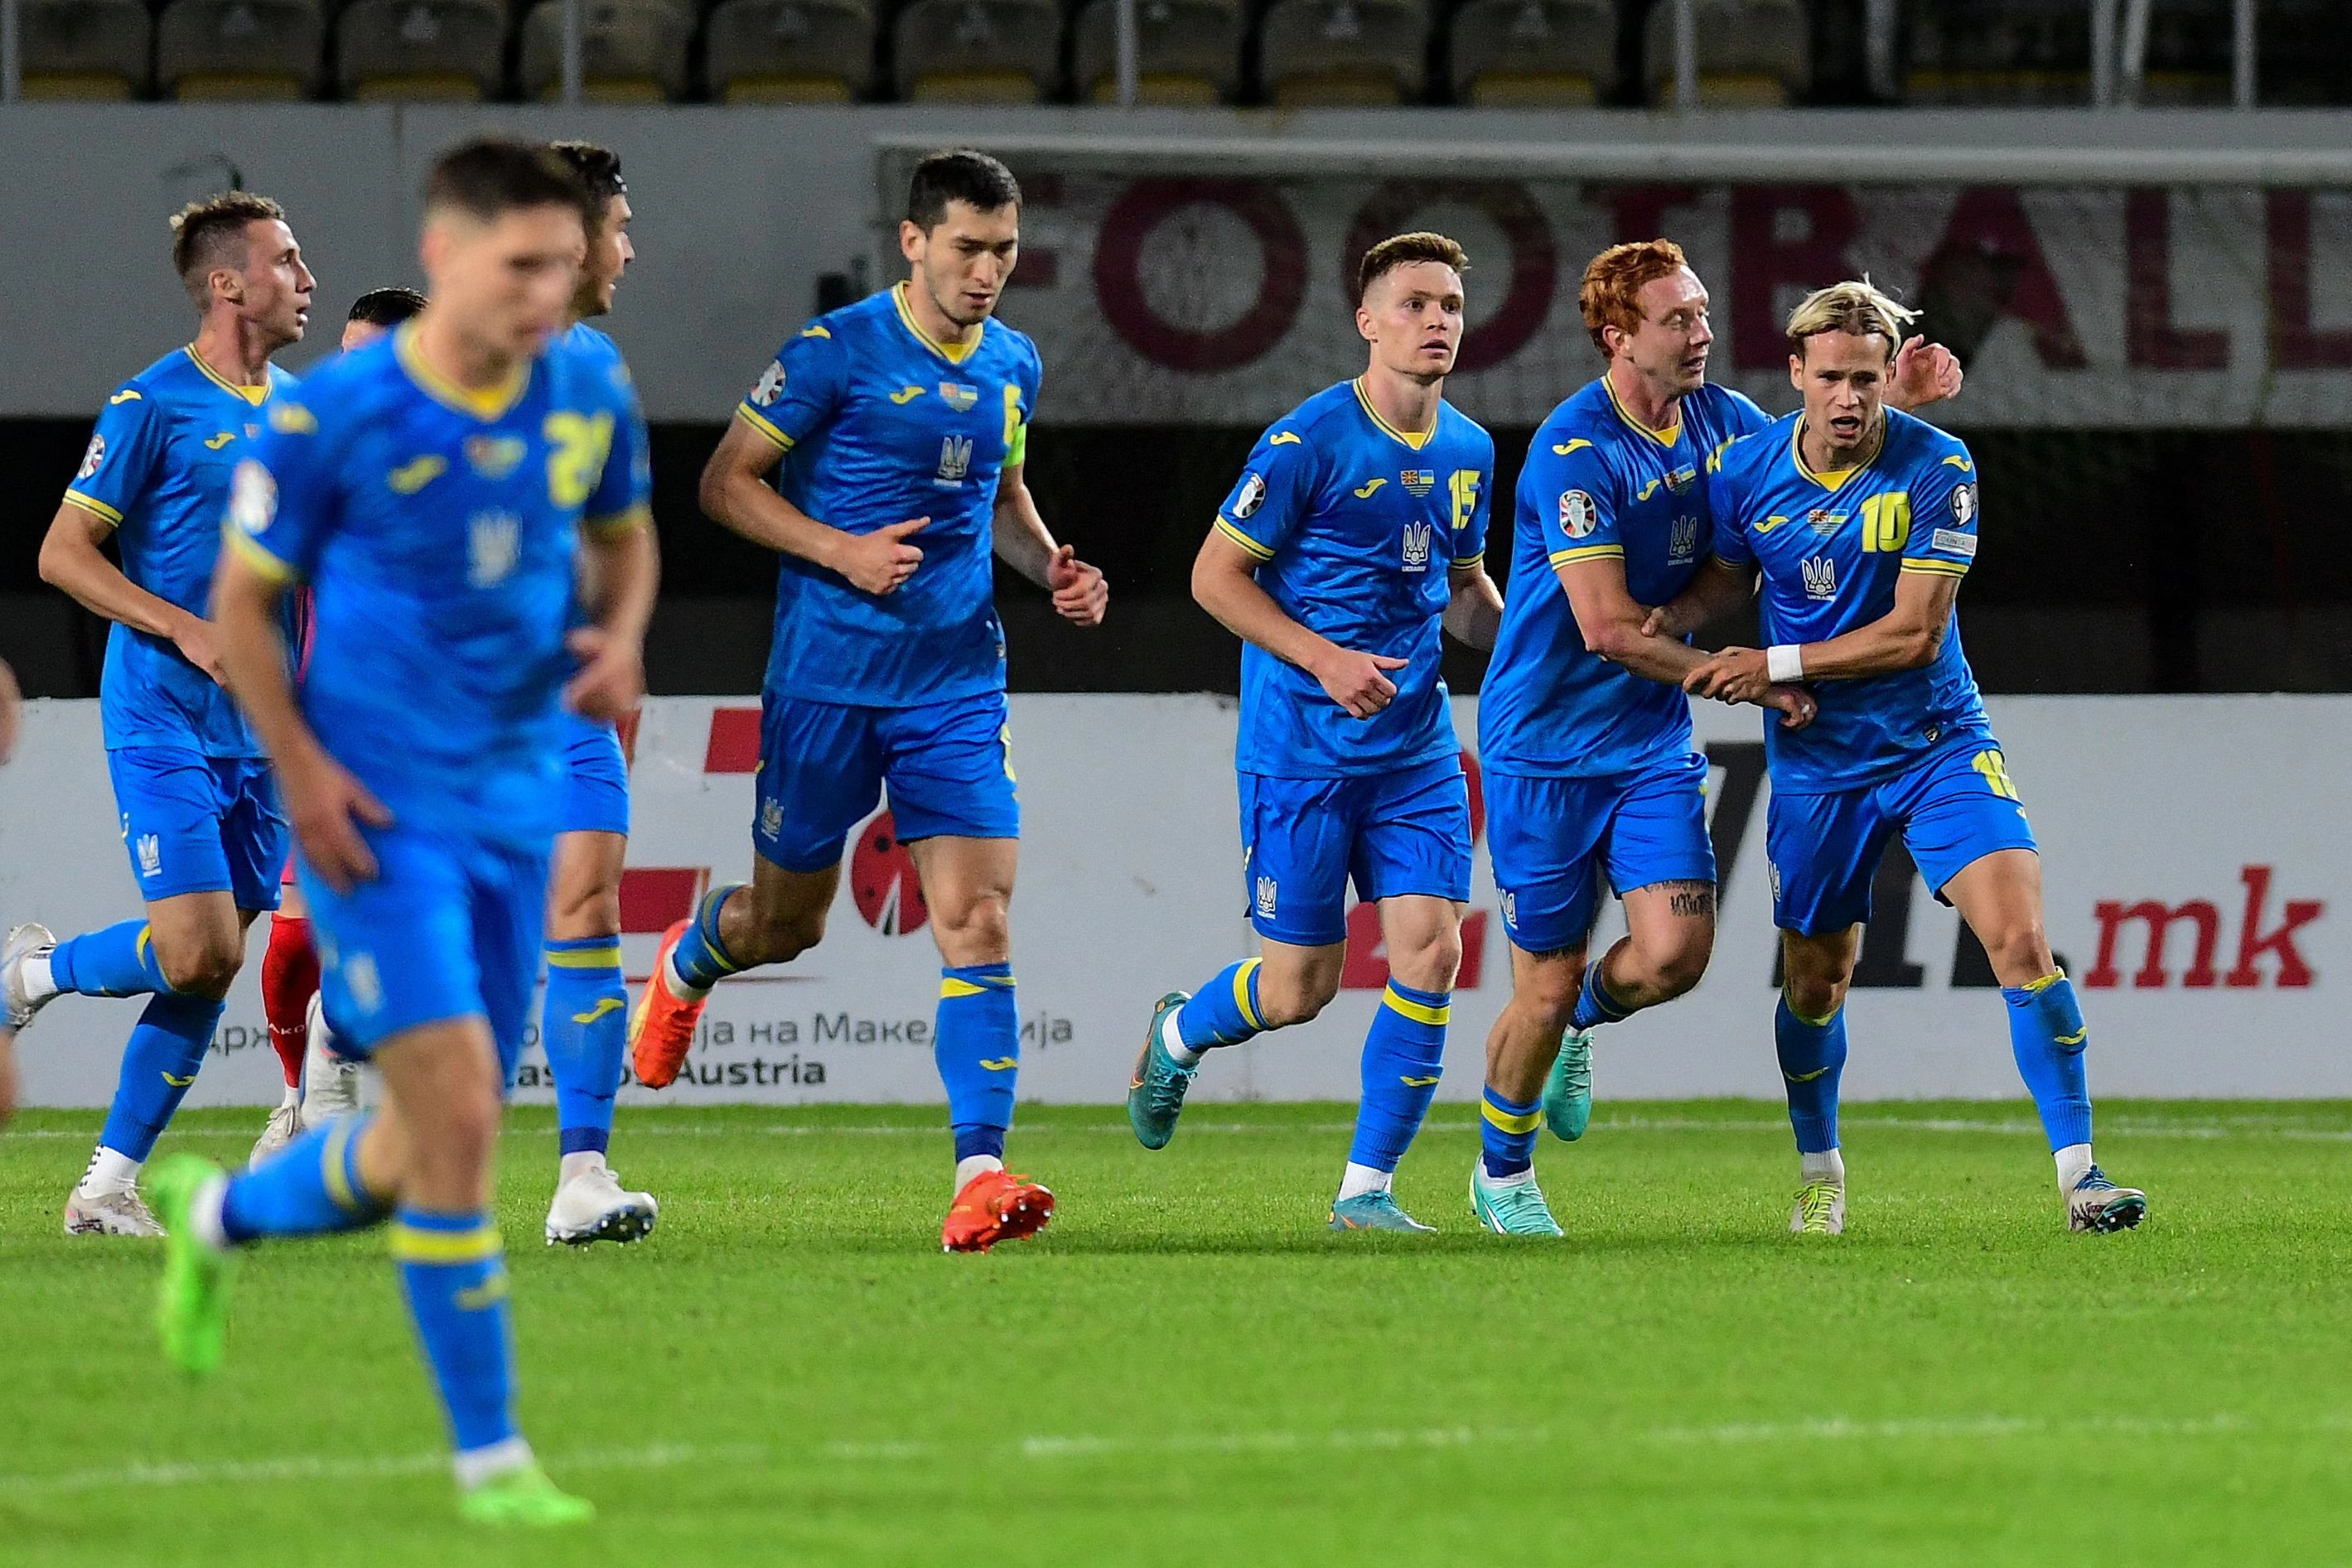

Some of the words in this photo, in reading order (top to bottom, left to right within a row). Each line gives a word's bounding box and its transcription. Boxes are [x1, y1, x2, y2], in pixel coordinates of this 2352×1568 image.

[1448, 469, 1481, 530] 15
[1861, 491, 1910, 552] 10
[750, 1020, 799, 1046] на
[814, 1011, 1074, 1050] Макеија
[672, 1053, 827, 1086] Austria
